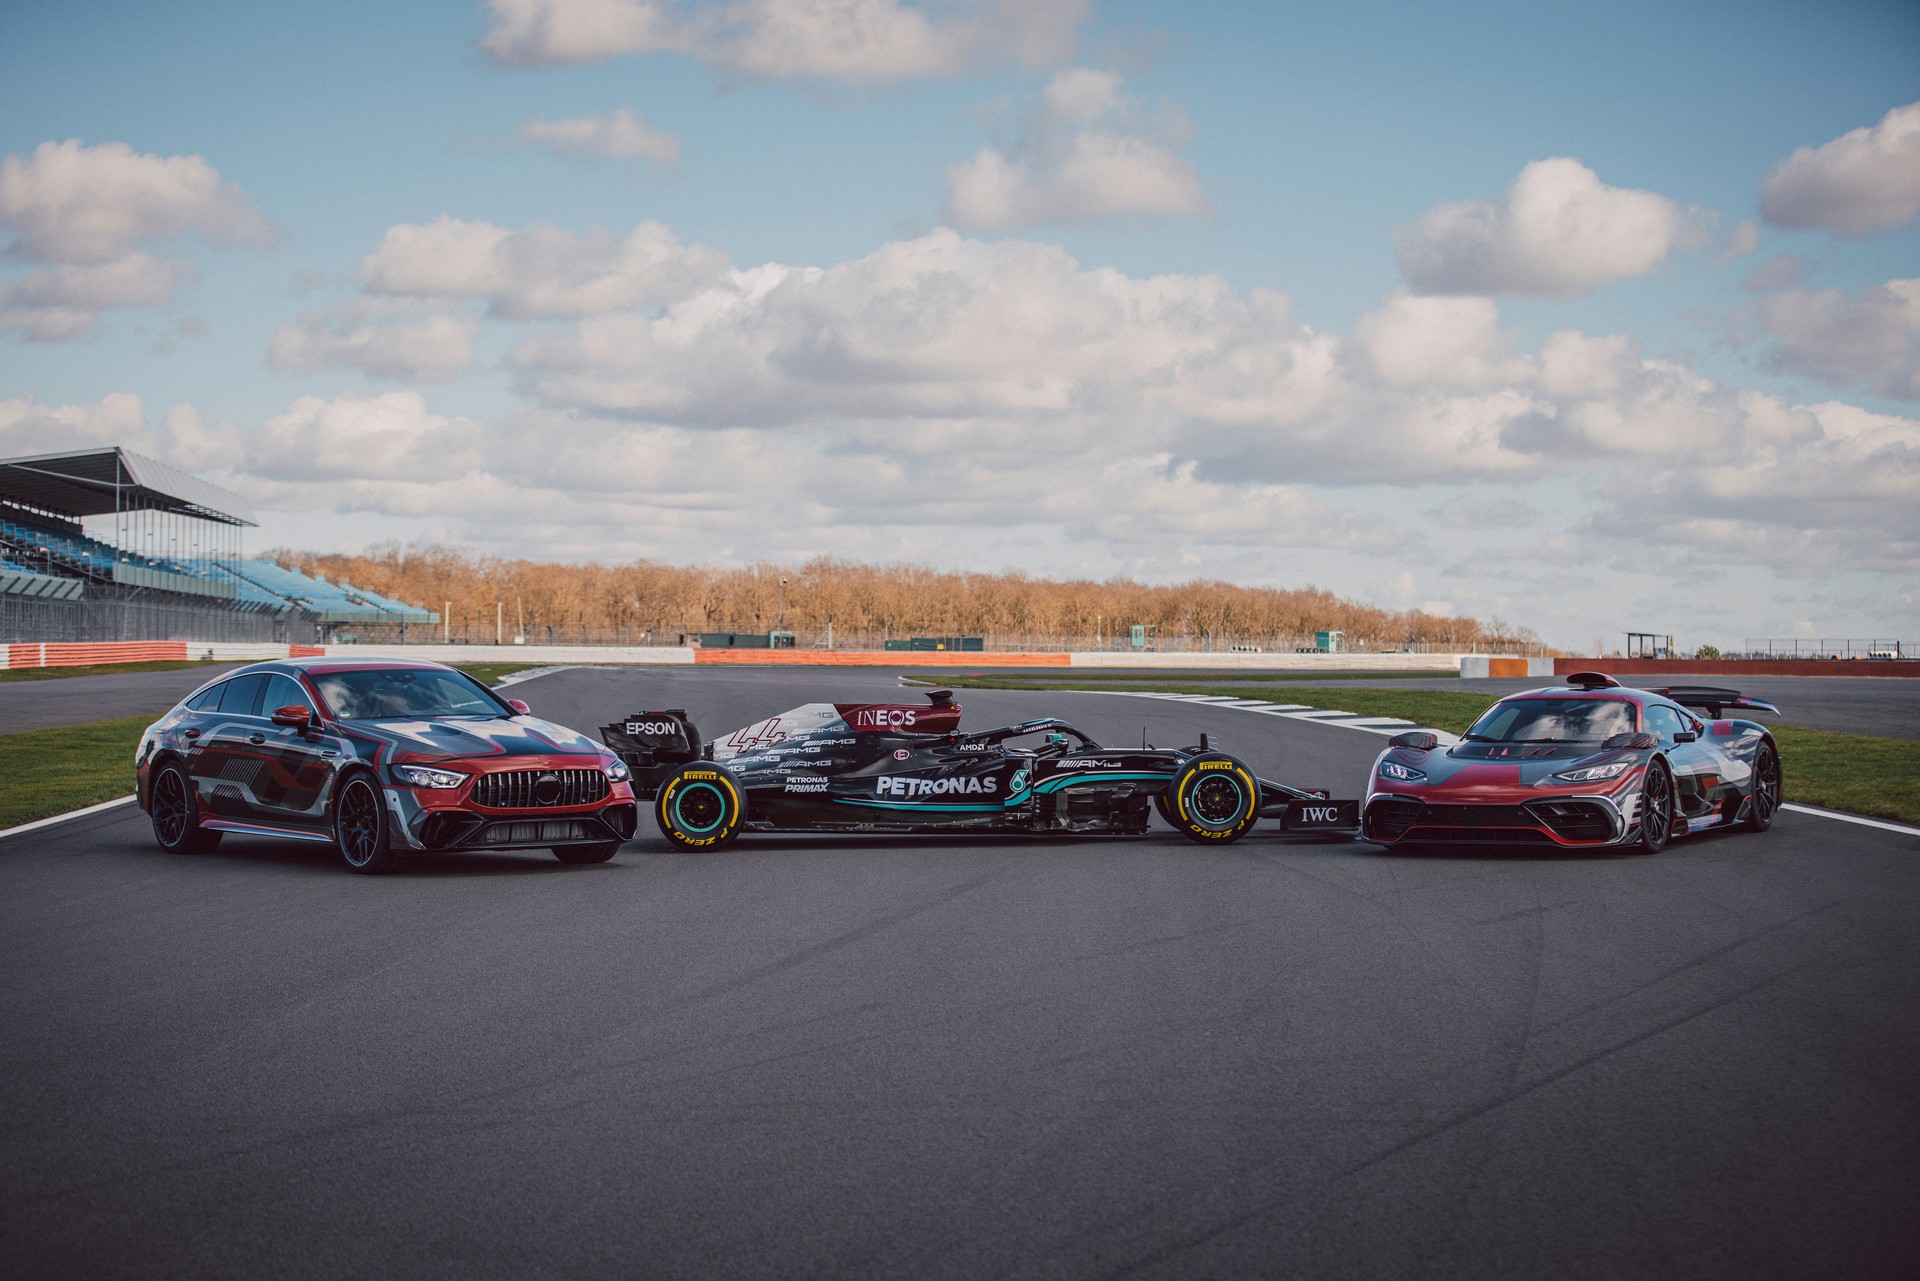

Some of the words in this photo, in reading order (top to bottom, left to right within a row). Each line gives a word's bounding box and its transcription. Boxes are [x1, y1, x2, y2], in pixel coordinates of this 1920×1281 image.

[857, 710, 916, 726] INEOS
[626, 722, 675, 735] EPSON
[727, 718, 787, 754] 44
[819, 738, 856, 746] AMG
[1199, 761, 1233, 771] PIRELLI
[683, 770, 717, 780] PIRELLI
[784, 783, 831, 793] PRIMAX
[877, 776, 998, 796] PETRONAS
[1302, 807, 1338, 822] IWC
[1190, 824, 1233, 839] ZERO
[1237, 819, 1246, 831] P
[673, 831, 716, 846] ZERO
[720, 827, 729, 839] P
